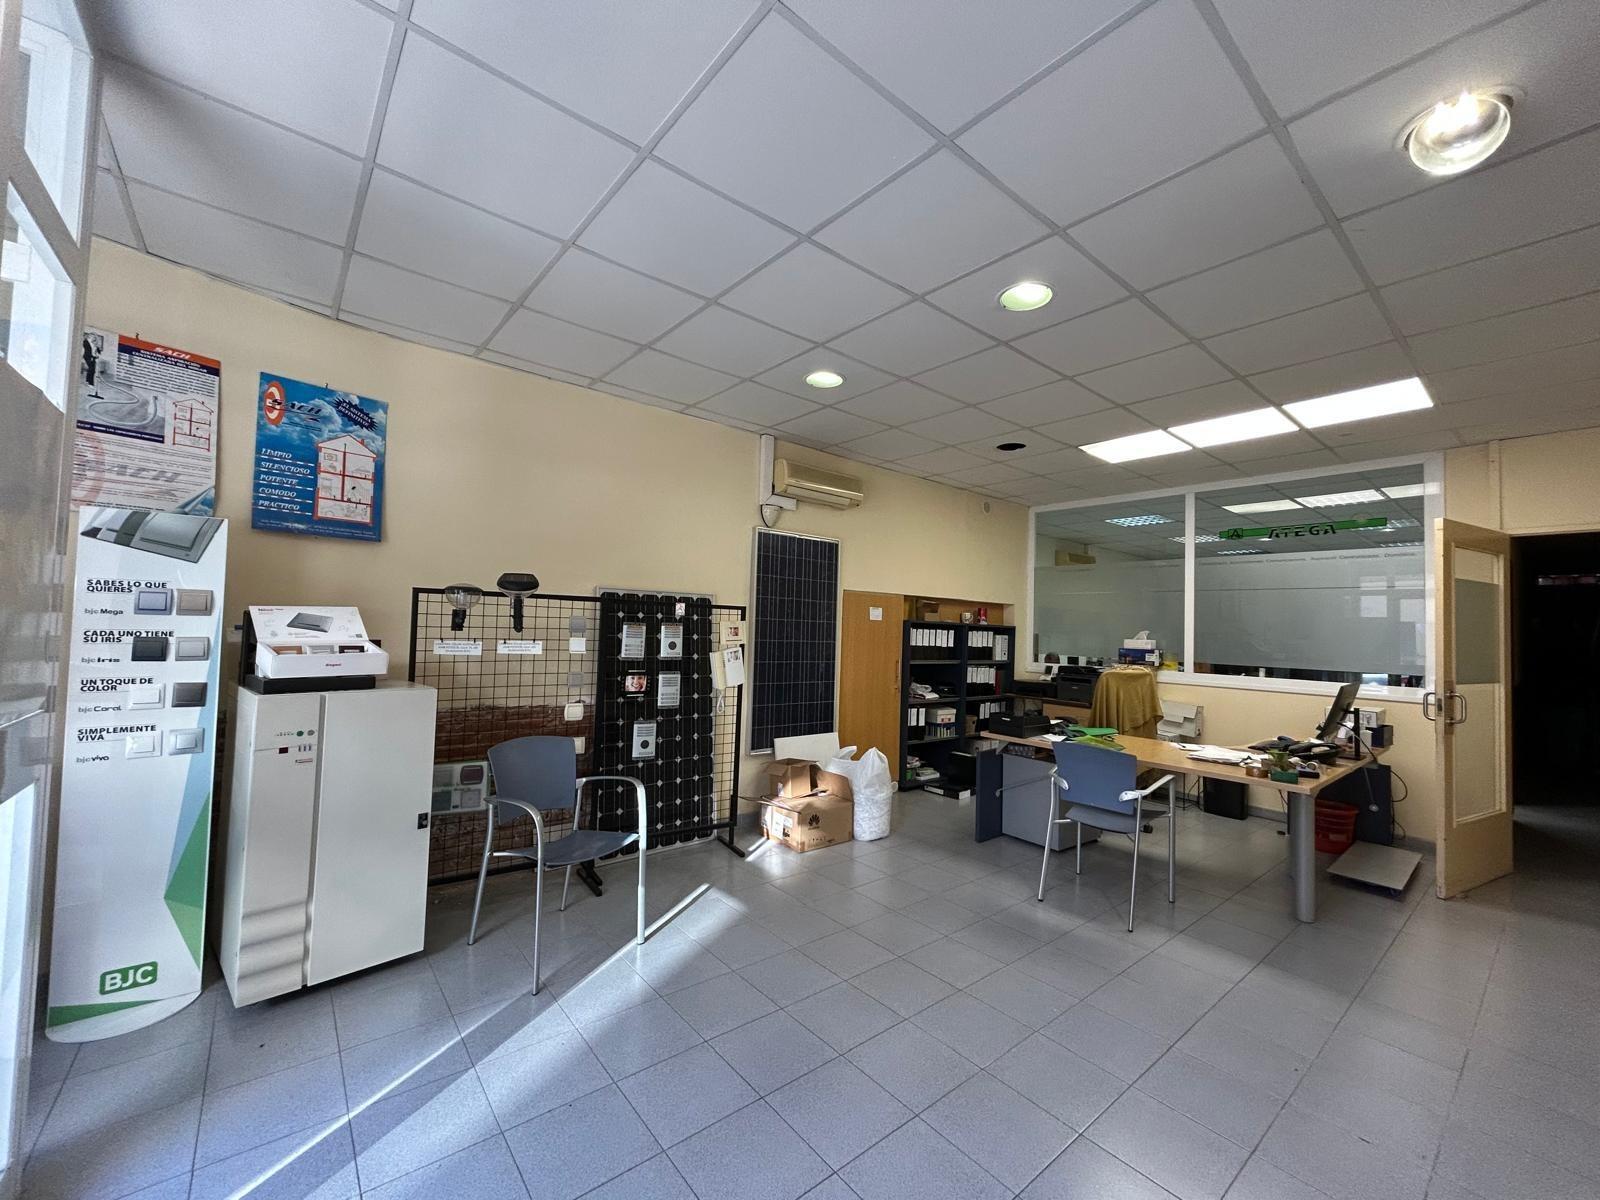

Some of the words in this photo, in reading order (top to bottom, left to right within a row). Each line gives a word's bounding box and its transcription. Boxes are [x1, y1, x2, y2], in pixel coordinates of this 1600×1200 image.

[261, 448, 292, 459] LIMPIO
[261, 461, 310, 475] SILENCIOSO
[260, 474, 299, 485] POTENTE
[259, 487, 297, 498] COMODO
[258, 500, 300, 511] PRACTICO
[87, 579, 124, 587] SABES
[86, 585, 133, 593] QUIERES
[100, 608, 124, 616] Mega
[118, 630, 143, 638] UNO
[144, 630, 174, 638] TIENE
[100, 678, 137, 686] TOQUE
[80, 684, 118, 692] COLOR
[77, 725, 157, 735] SIMPLEMENTE
[104, 965, 154, 992] BJC
